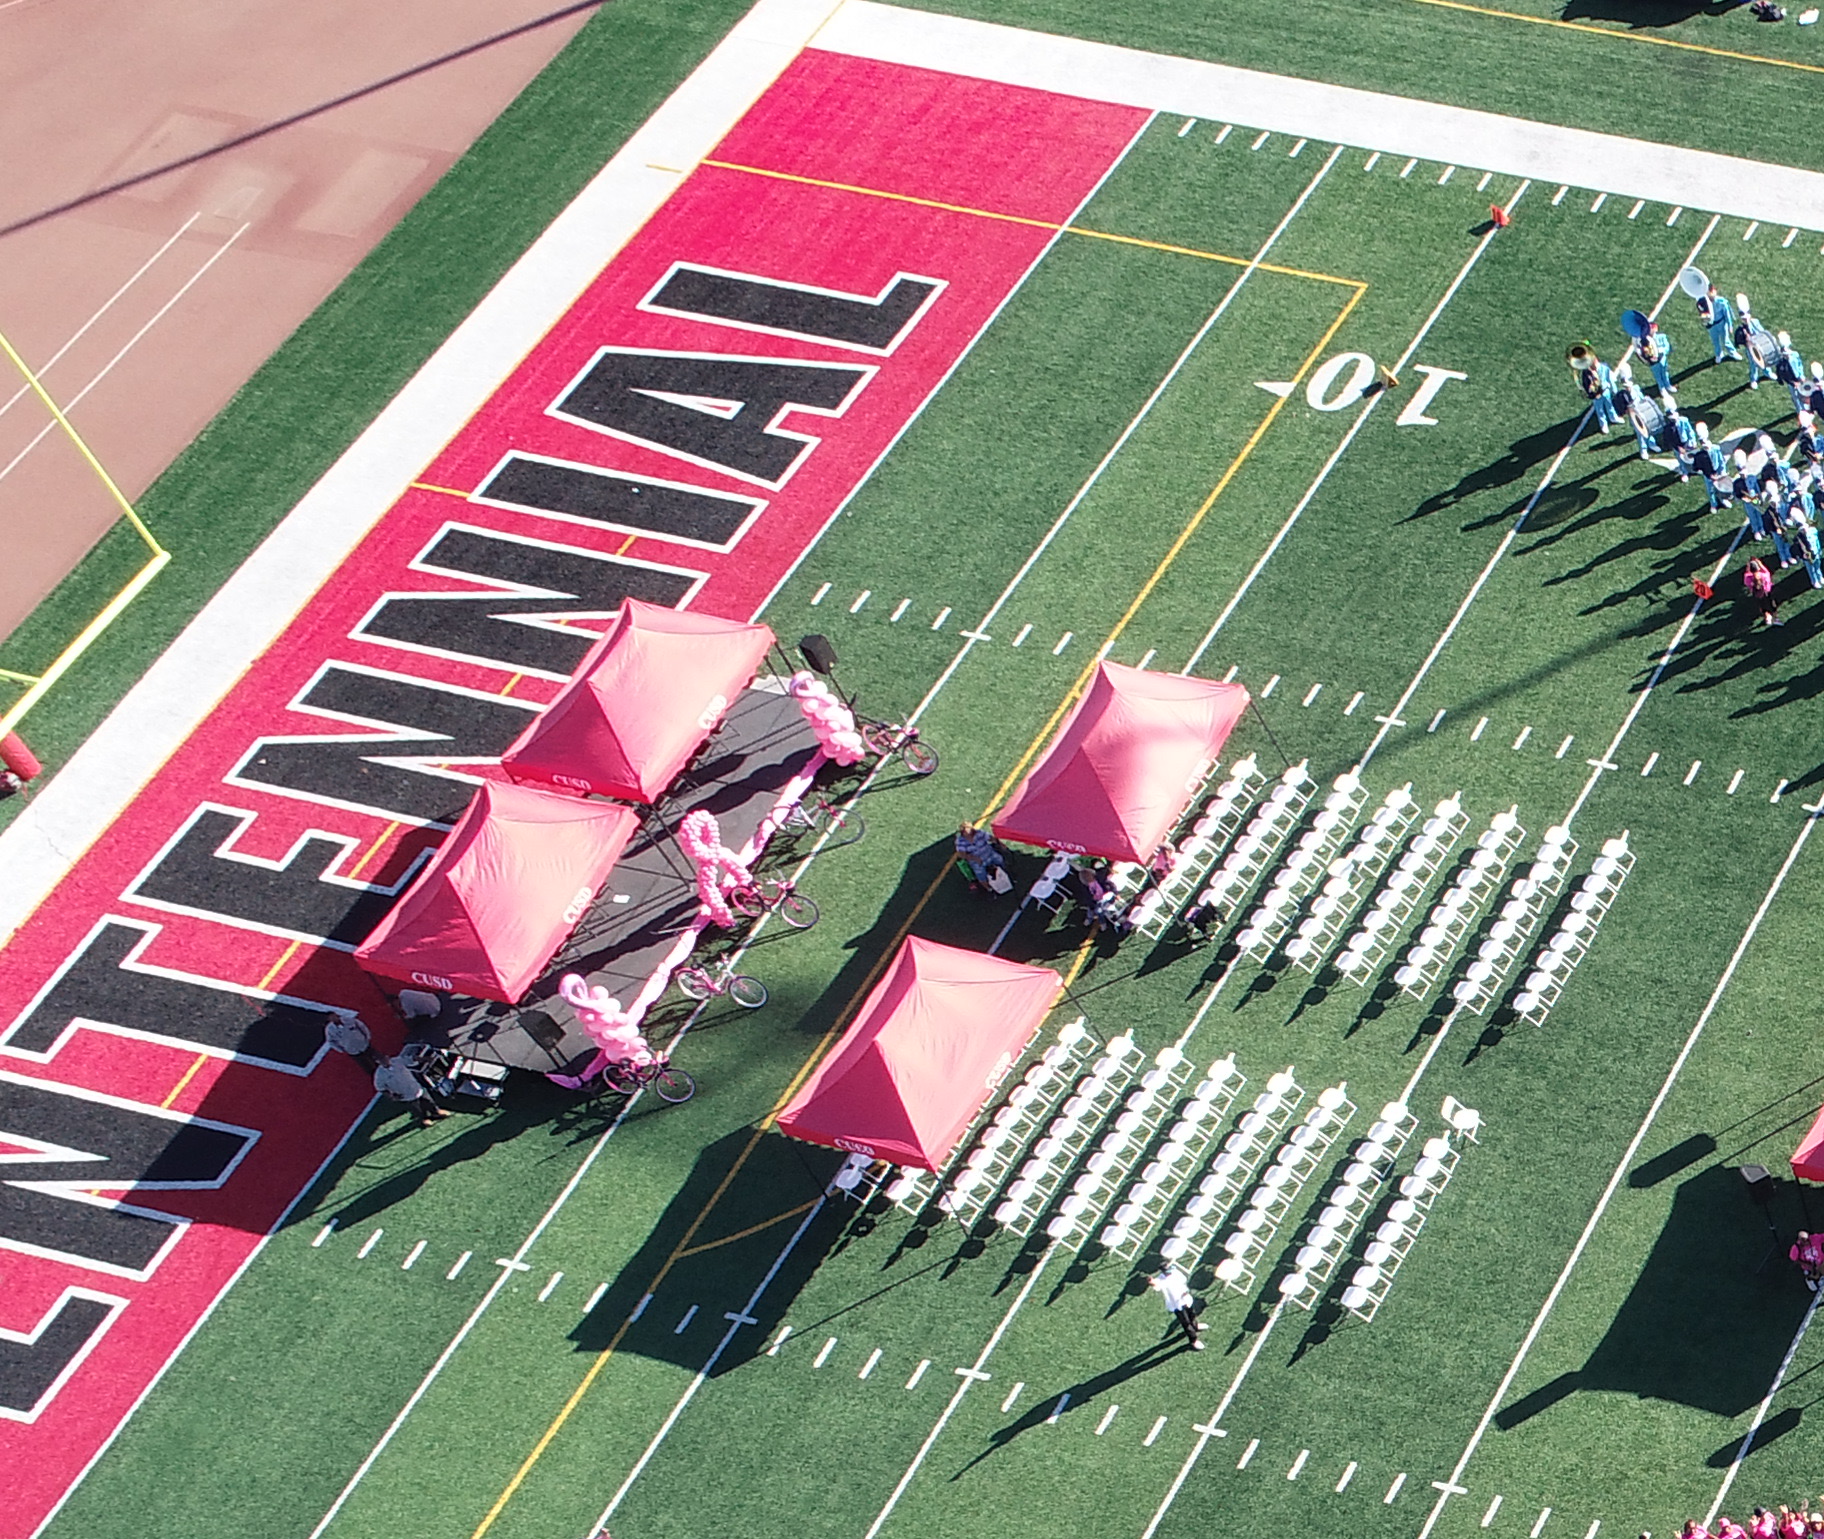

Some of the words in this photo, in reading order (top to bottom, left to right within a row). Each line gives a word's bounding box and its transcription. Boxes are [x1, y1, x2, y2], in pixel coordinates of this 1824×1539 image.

[552, 774, 591, 791] CUSD
[563, 887, 592, 924] CUSD
[412, 971, 453, 990] CUSD
